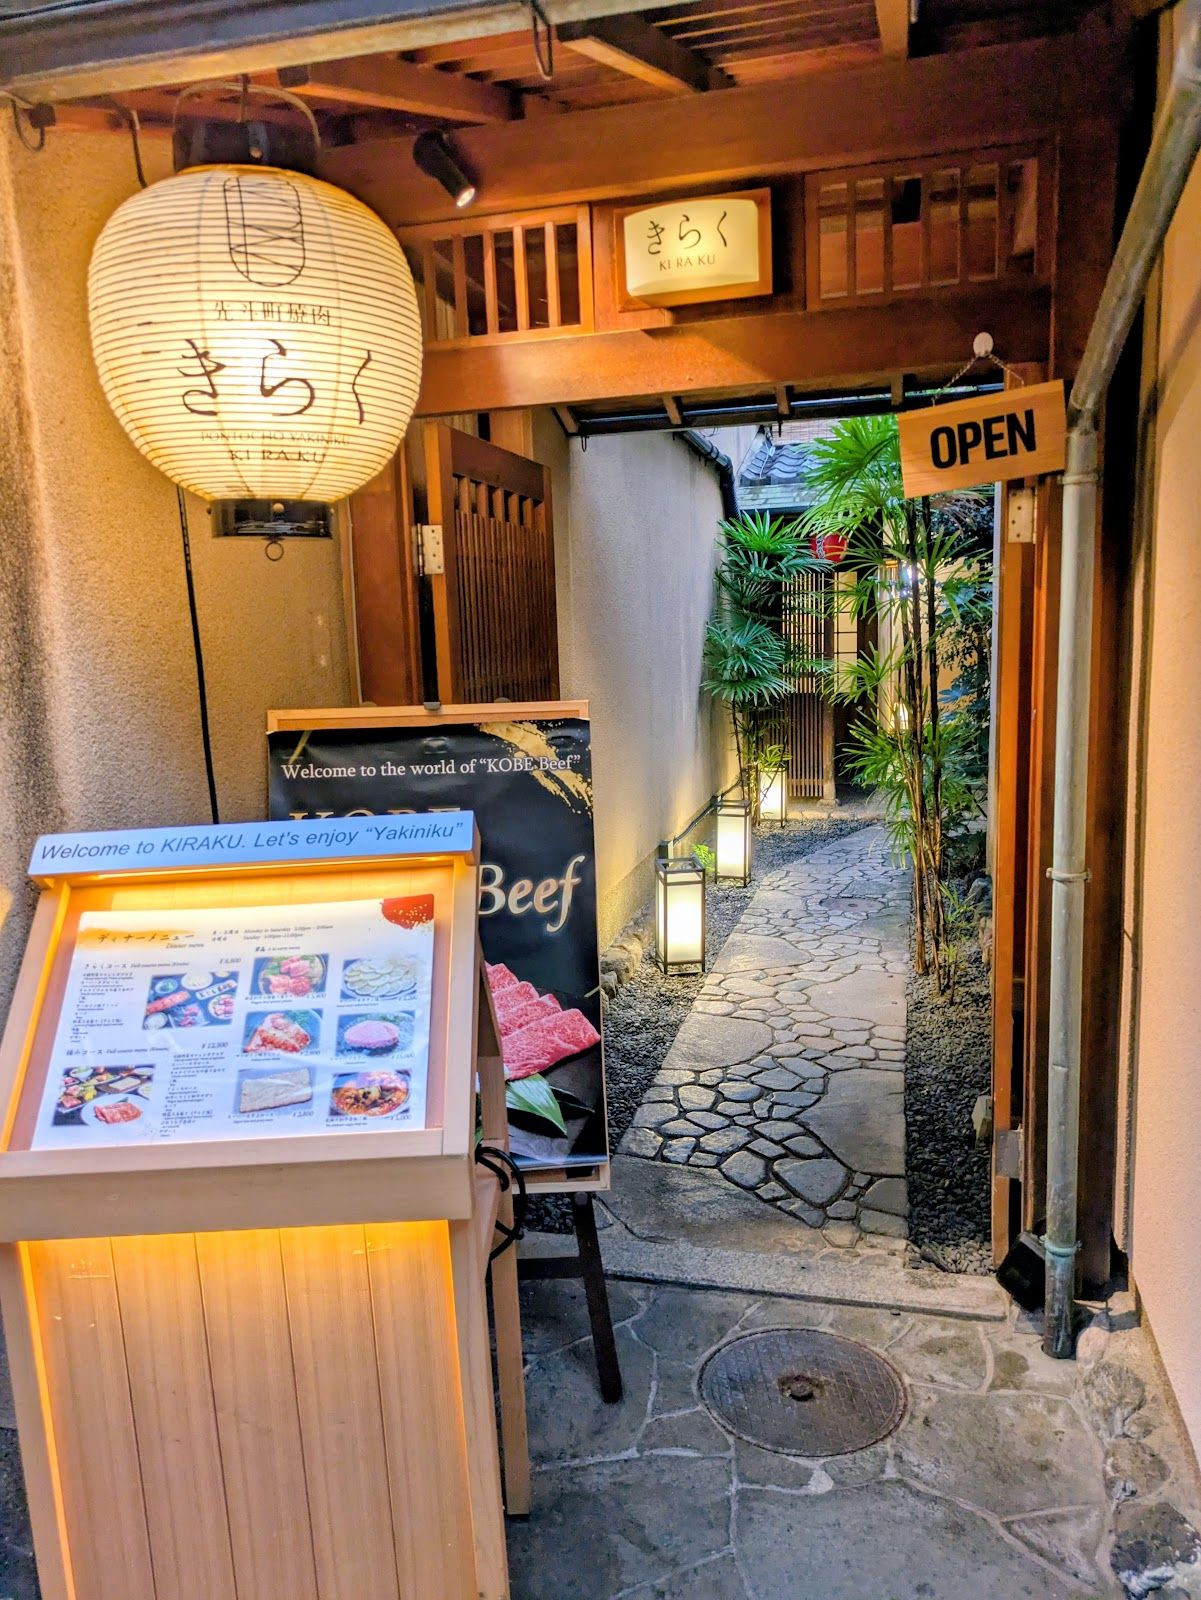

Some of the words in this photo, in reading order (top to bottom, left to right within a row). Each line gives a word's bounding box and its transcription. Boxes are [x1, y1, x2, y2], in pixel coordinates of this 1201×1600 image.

[646, 209, 728, 255] きらく
[176, 337, 373, 426] きらく
[930, 408, 1037, 470] OPEN
[281, 763, 356, 780] Welcome
[360, 764, 377, 777] to
[380, 761, 406, 777] the
[410, 759, 456, 776] world
[460, 758, 478, 775] of
[41, 843, 130, 861] Welcome
[136, 840, 155, 855] to
[160, 833, 245, 854] KIRAKU.
[253, 830, 299, 849] Let's
[305, 828, 360, 848] enjoy
[478, 854, 586, 935] Beef
